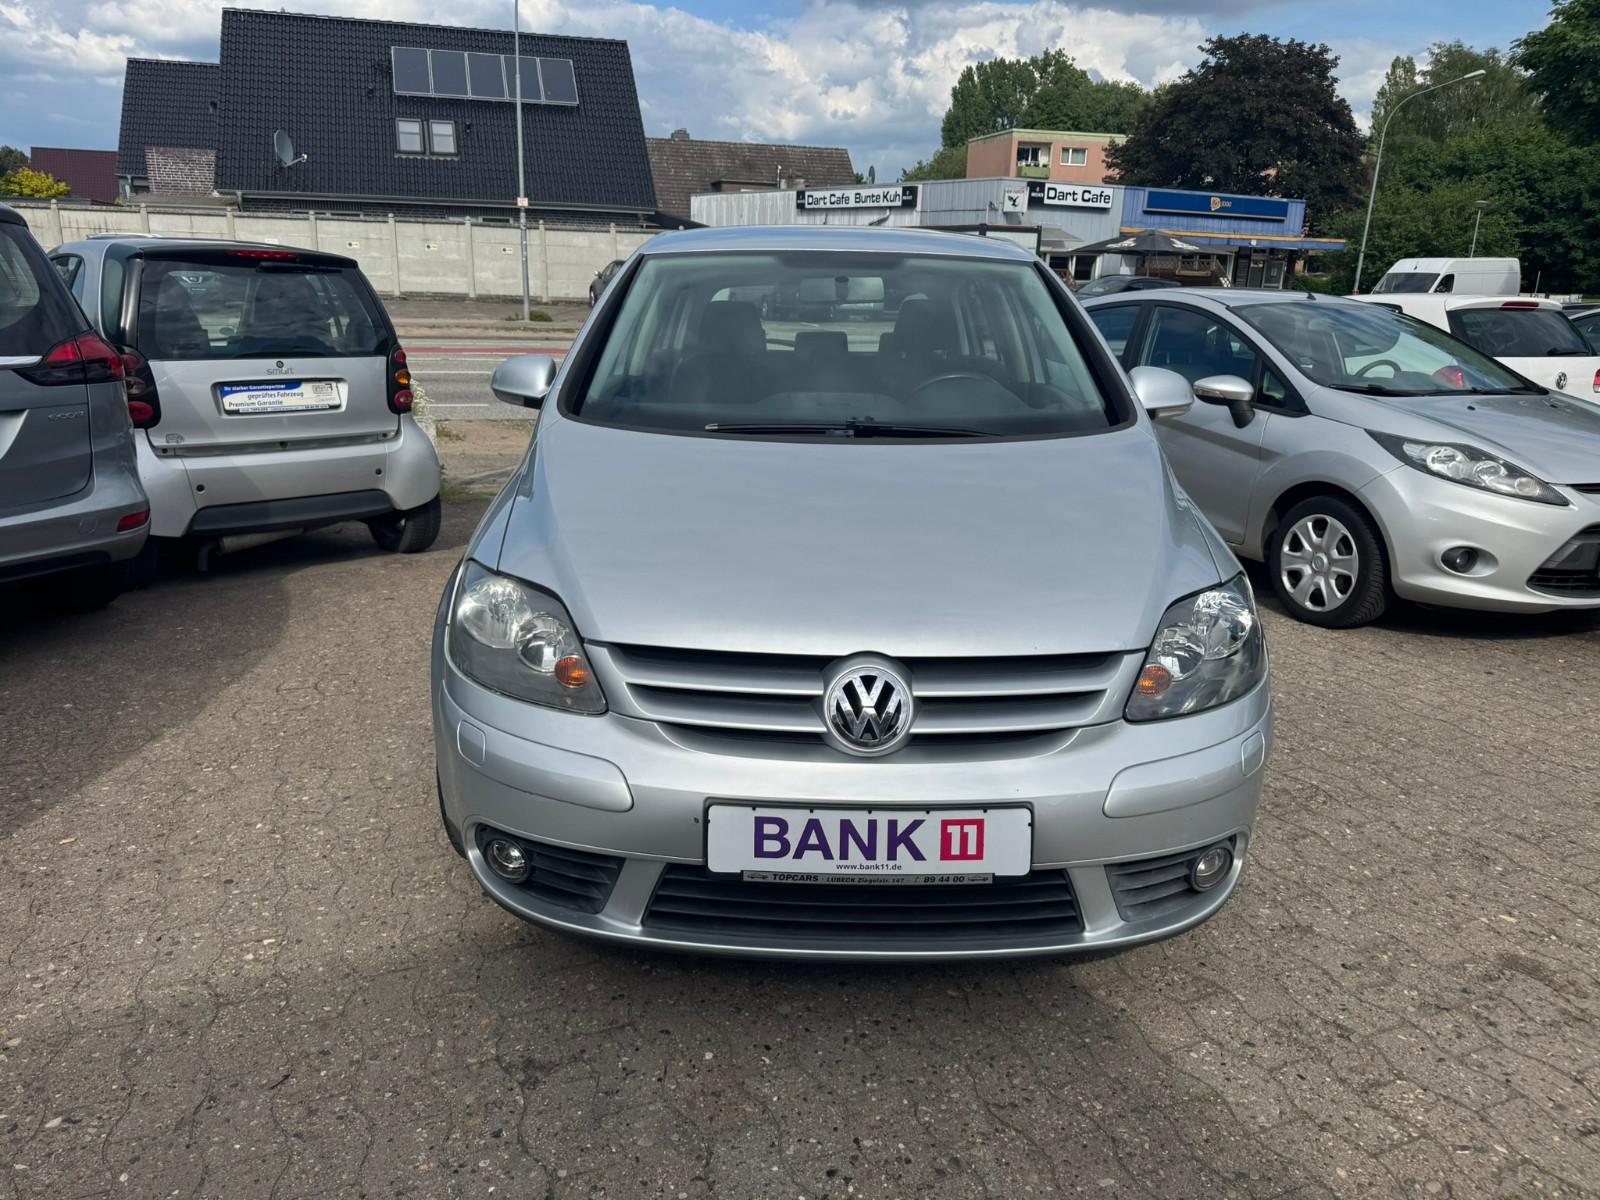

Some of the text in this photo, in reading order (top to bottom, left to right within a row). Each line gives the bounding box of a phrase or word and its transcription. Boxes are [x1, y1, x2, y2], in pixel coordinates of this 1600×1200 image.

[807, 194, 827, 206] Dart
[829, 193, 850, 205] Cafe
[854, 192, 881, 204] Bunte
[882, 190, 901, 203] Kuh
[1046, 187, 1078, 202] Dart
[1081, 189, 1111, 204] Cafe
[754, 816, 978, 861] BANK 11
[836, 862, 902, 872] www.bank11.de
[772, 873, 819, 882] TOPCARS
[952, 875, 965, 883] 00
